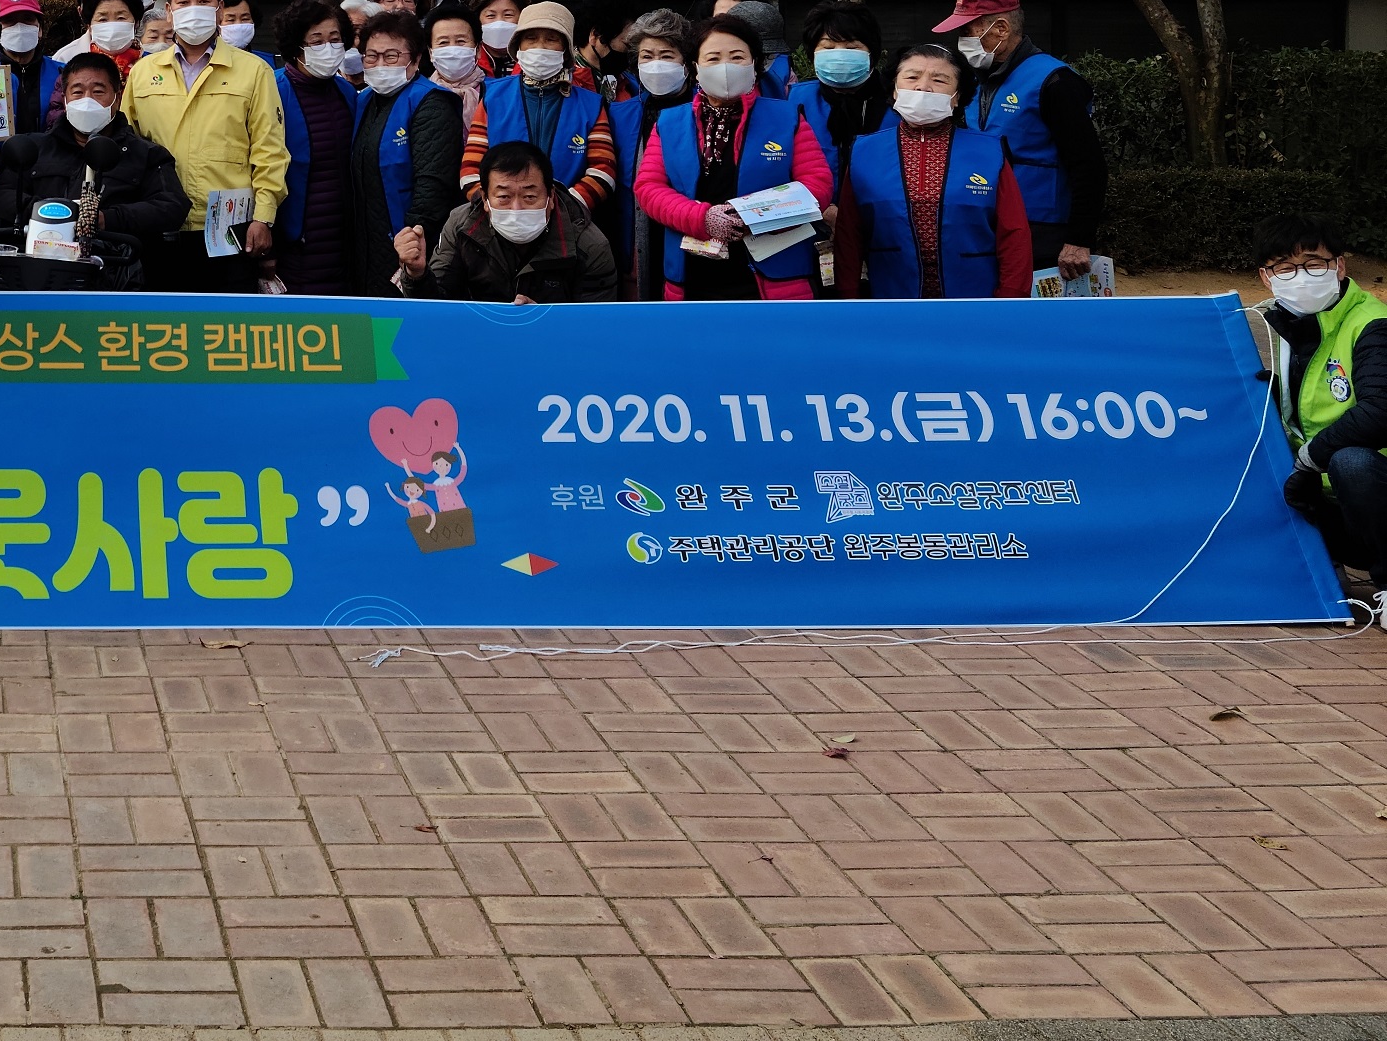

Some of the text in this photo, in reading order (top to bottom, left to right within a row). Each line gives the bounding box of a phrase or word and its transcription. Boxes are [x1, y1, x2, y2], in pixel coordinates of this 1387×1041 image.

[97, 321, 188, 371] 환경
[203, 323, 343, 373] 캠페인
[537, 390, 1209, 443] 2020. 11. 13.(금) 16:00~
[549, 484, 606, 511] 후원
[876, 479, 1081, 511] 완주소셜굿즈센터
[667, 531, 1030, 563] 주택관리공단 완주봉동관리소
